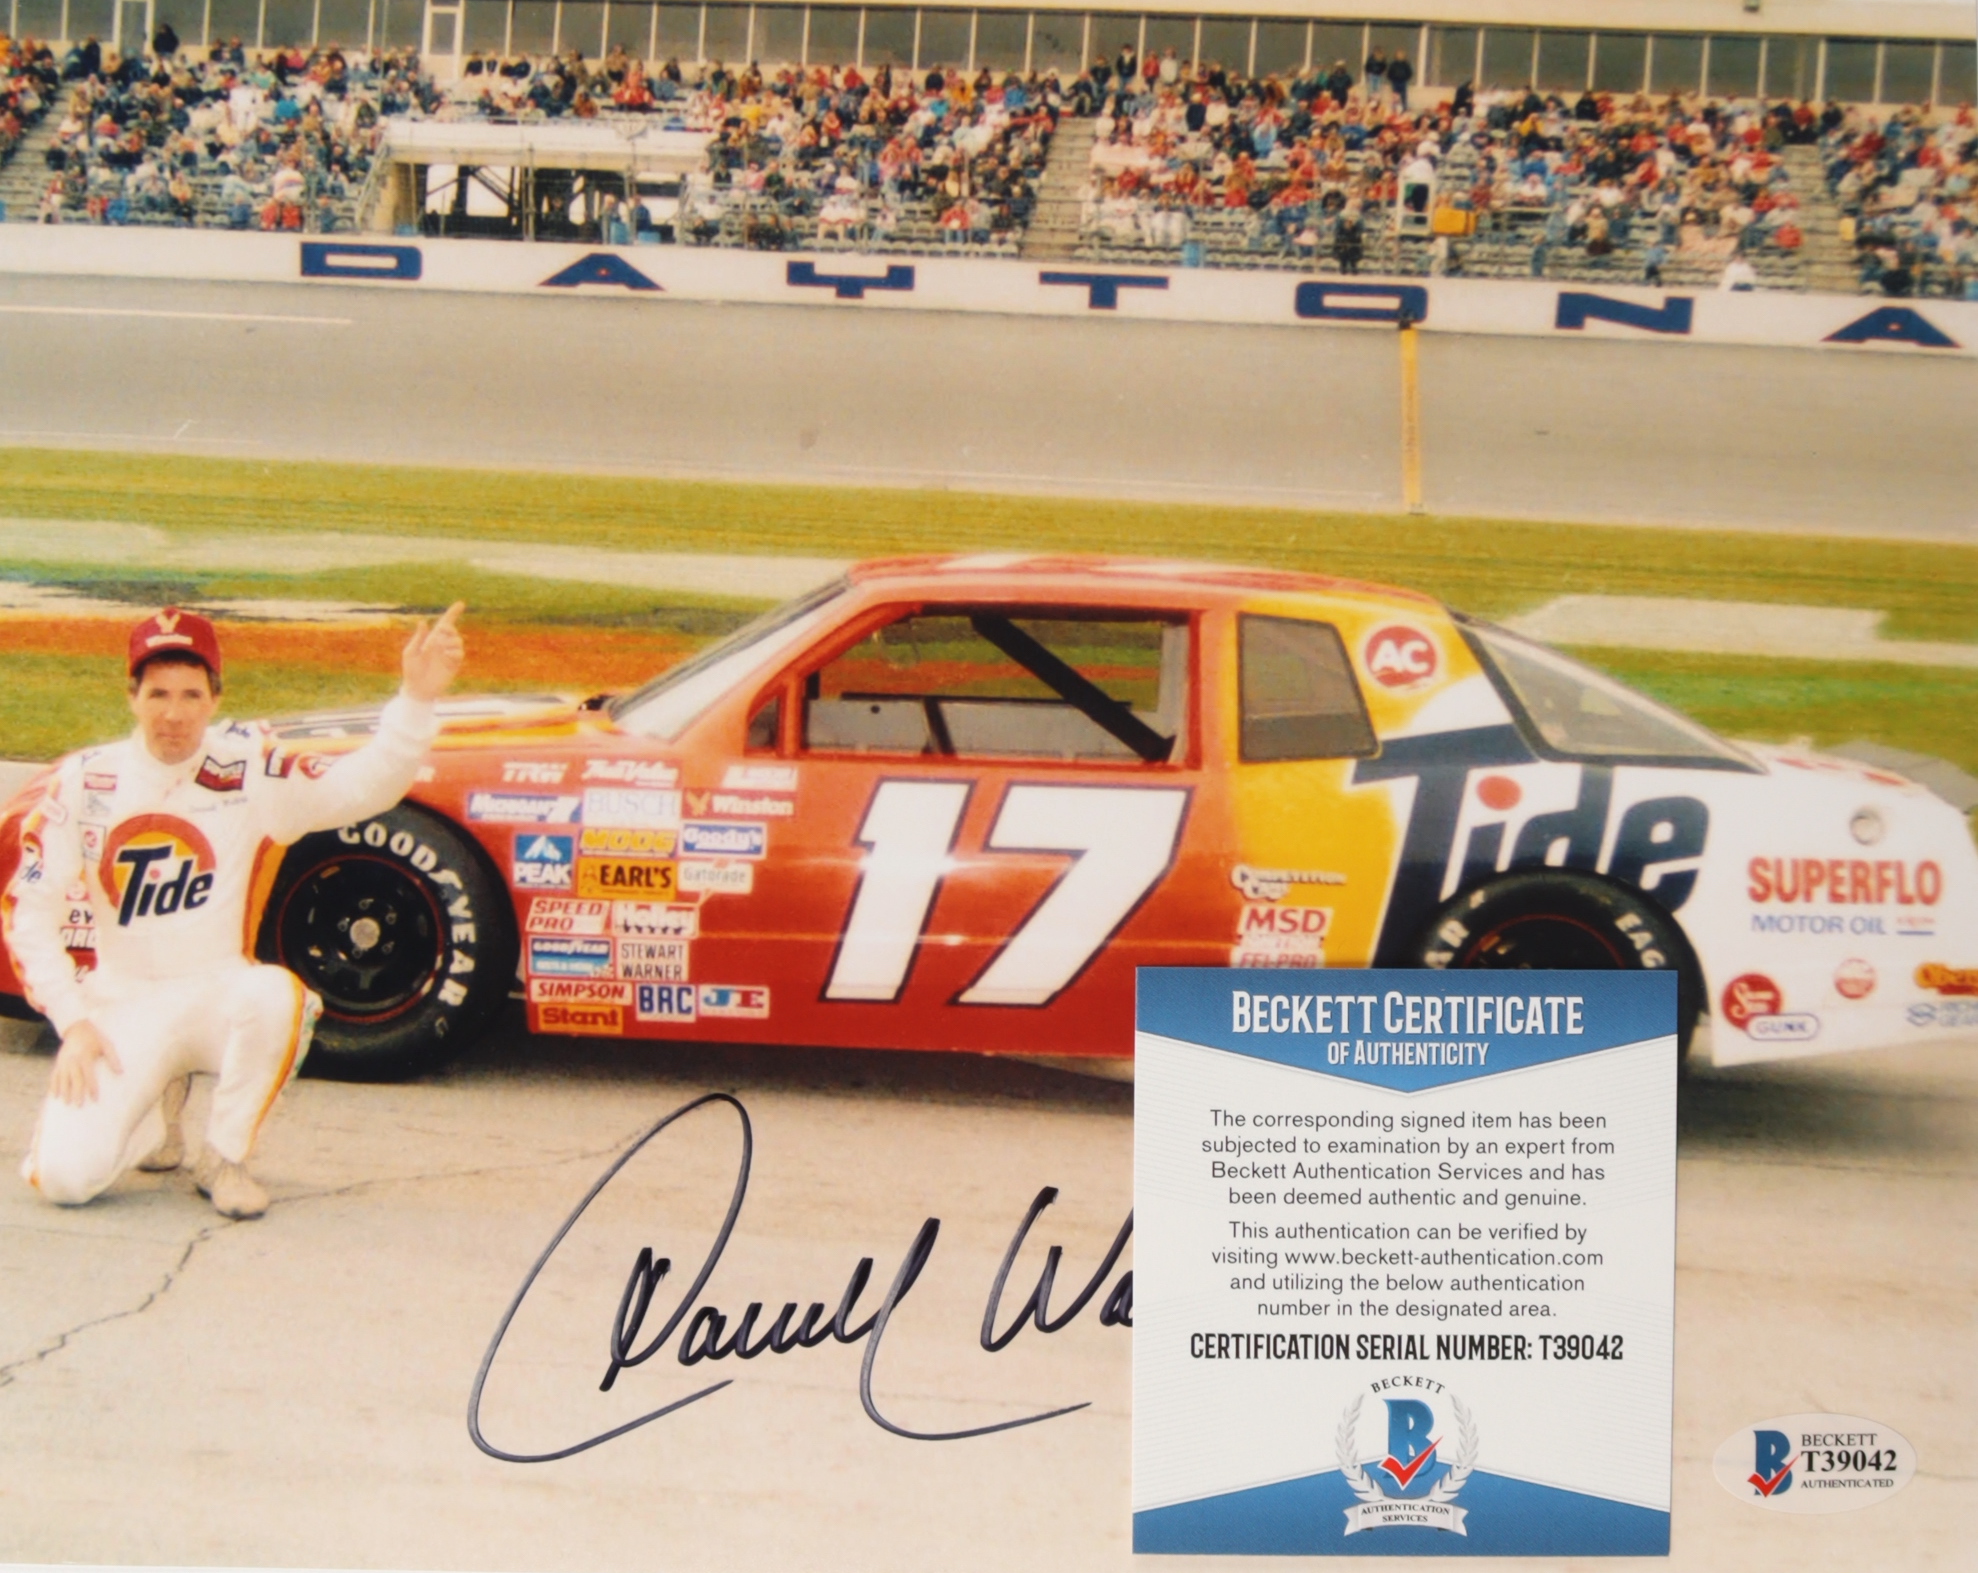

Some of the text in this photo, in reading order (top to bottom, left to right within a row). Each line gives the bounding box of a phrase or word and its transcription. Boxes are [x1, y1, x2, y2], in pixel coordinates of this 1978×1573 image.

[300, 238, 1962, 350] DAYTONA
[1371, 639, 1430, 674] AC
[579, 829, 676, 854] MOOG
[1352, 724, 1713, 968] Tide
[515, 862, 573, 885] PEAK
[600, 863, 673, 889] EARL'S
[683, 867, 746, 884] Gatorade
[1746, 856, 1943, 906] SUPERFLO
[116, 845, 218, 928] Tide
[818, 775, 1196, 1009] 17
[532, 900, 604, 916] SPEED
[528, 916, 574, 932] PRO
[1245, 907, 1327, 934] MSD
[1751, 912, 1844, 935] MOTOR
[1849, 916, 1886, 936] OIL
[621, 943, 684, 960] STEWART
[621, 963, 683, 980] WARNER
[537, 982, 626, 999] SIMPSON
[638, 985, 693, 1014] BRC
[541, 1007, 620, 1027] Stant
[1232, 990, 1585, 1035] BECKETT CERTIFICATE
[1327, 1039, 1489, 1066] OF AUTHENTICITY
[1210, 1109, 1606, 1133] The corresponding signed item has been
[1202, 1135, 1615, 1159] subjected to examination by an expert from
[1212, 1160, 1605, 1181] Beckett Authentication Services and has
[1229, 1187, 1586, 1211] been deemed authentic and genuine.
[1229, 1221, 1587, 1245] This authentication can be verified by
[1212, 1247, 1603, 1269] visiting www.beckett-authentication.com
[1230, 1273, 1585, 1295] and utilizing the below authentication
[1258, 1299, 1556, 1321] number in the designated area.
[1190, 1332, 1624, 1361] CERTIFICATION SERIAL NUMBER: T39042
[1370, 1375, 1446, 1394] BECKETT
[1801, 1433, 1878, 1447] BECKETT
[1800, 1449, 1898, 1473] T39042
[1800, 1479, 1895, 1489] AUTHENTICATED
[1360, 1503, 1451, 1516] AUTHENTICATION
[1382, 1514, 1429, 1523] SERVICES
